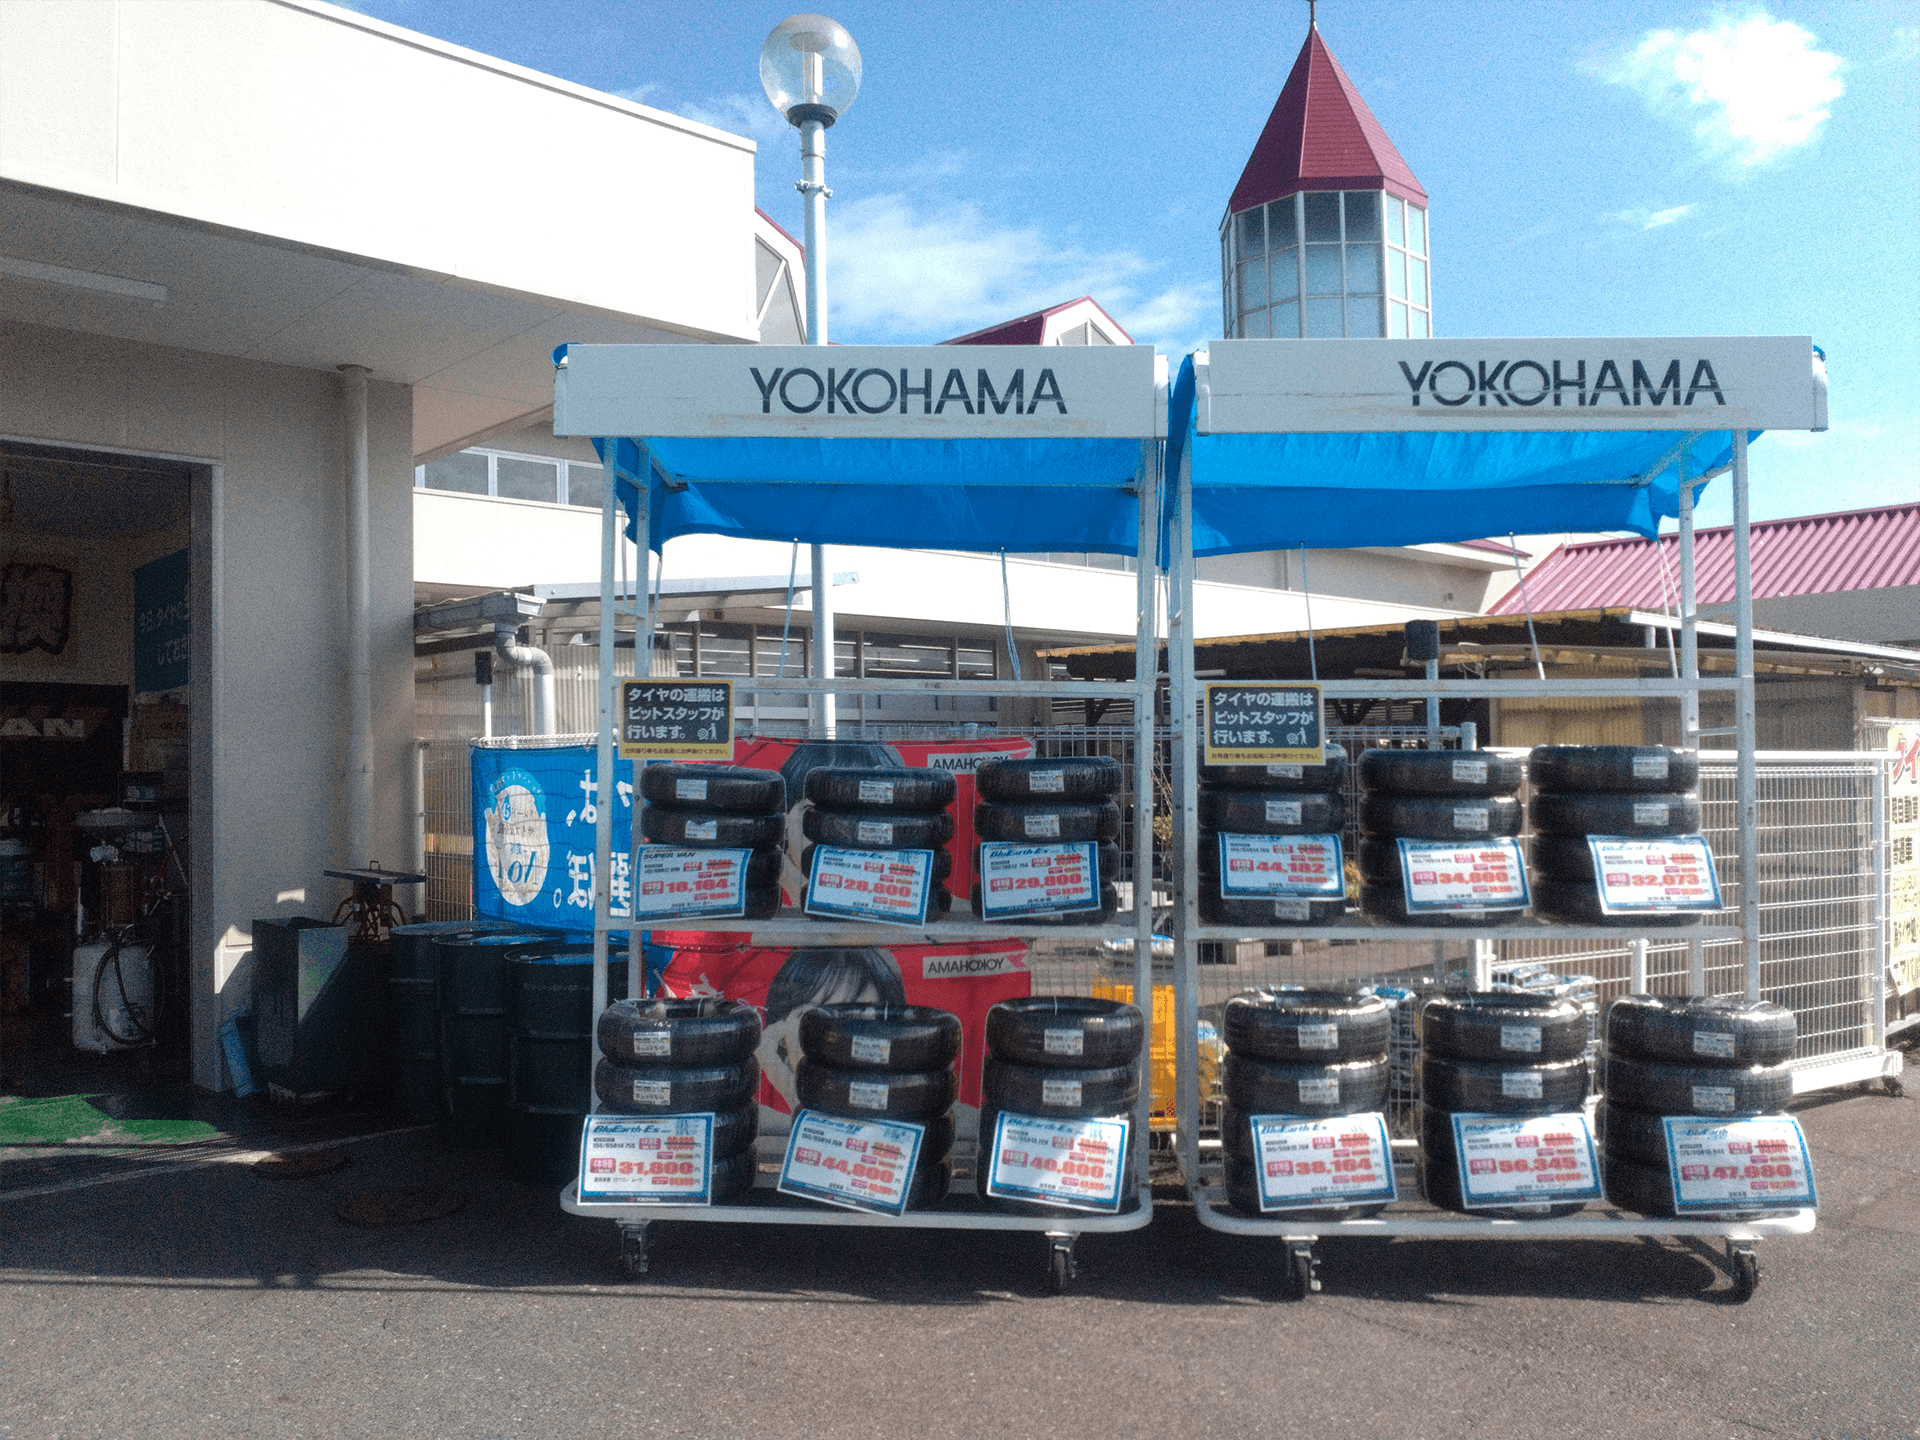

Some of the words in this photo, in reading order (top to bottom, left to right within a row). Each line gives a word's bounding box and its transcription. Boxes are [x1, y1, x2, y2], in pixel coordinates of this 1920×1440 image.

[1397, 359, 1726, 406] YOKOHAMA
[750, 367, 1068, 415] YOKOHAMA
[629, 688, 725, 702] タイヤの運搬は
[1214, 692, 1314, 706] タイヤの運搬は
[629, 707, 724, 721] ピットスタッフが
[1215, 711, 1314, 725] ピットスタッフが
[627, 724, 686, 739] 行います。
[1214, 729, 1274, 744] 行います。
[1015, 873, 1082, 890] 29,800
[593, 1125, 661, 1133] BluEarth-Es
[619, 1161, 694, 1175] 31,800
[821, 1156, 894, 1183] 44,800
